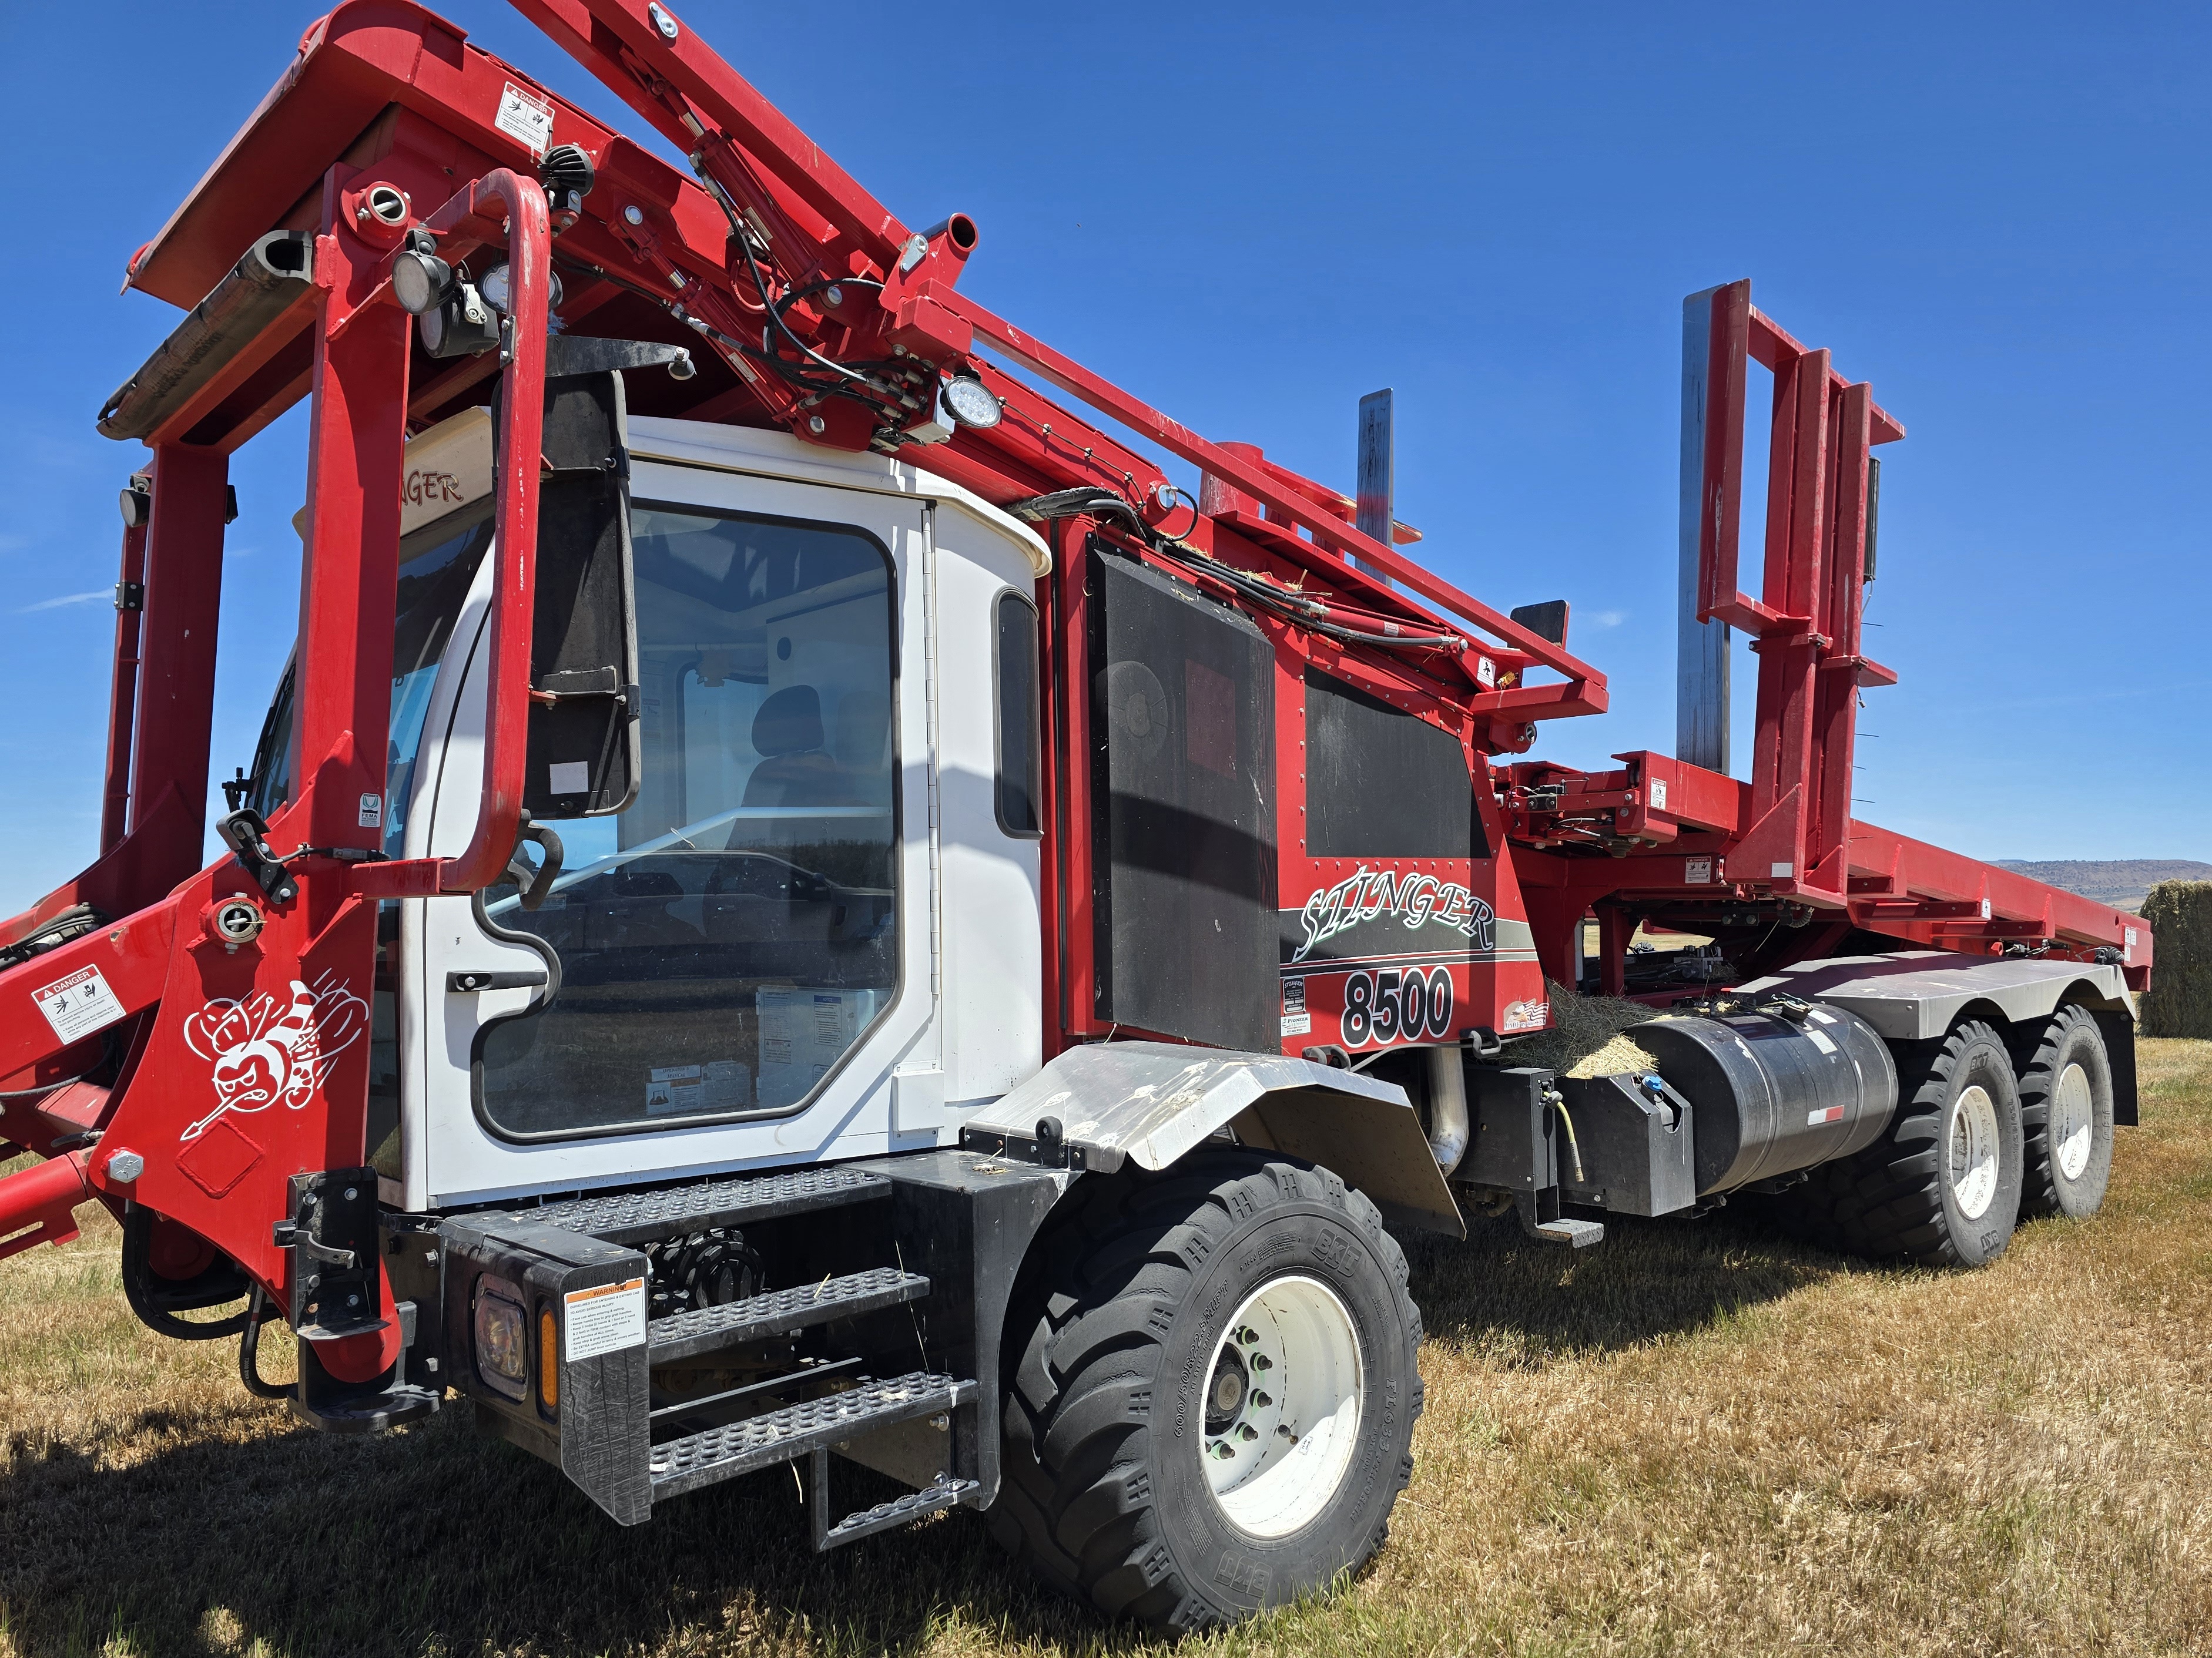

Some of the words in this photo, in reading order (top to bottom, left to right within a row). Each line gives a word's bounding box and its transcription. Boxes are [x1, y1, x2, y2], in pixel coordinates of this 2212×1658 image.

[520, 93, 548, 114] DANGER
[1292, 864, 1494, 964] STINGER
[53, 971, 91, 993] DANGER
[1340, 965, 1453, 1048] 8500
[1969, 1052, 1989, 1073] BKT
[1313, 1230, 1362, 1275] BKT
[1980, 1229, 2000, 1257] BKT
[1204, 1324, 1216, 1351] RADIAL
[1215, 1553, 1271, 1595] BKT
